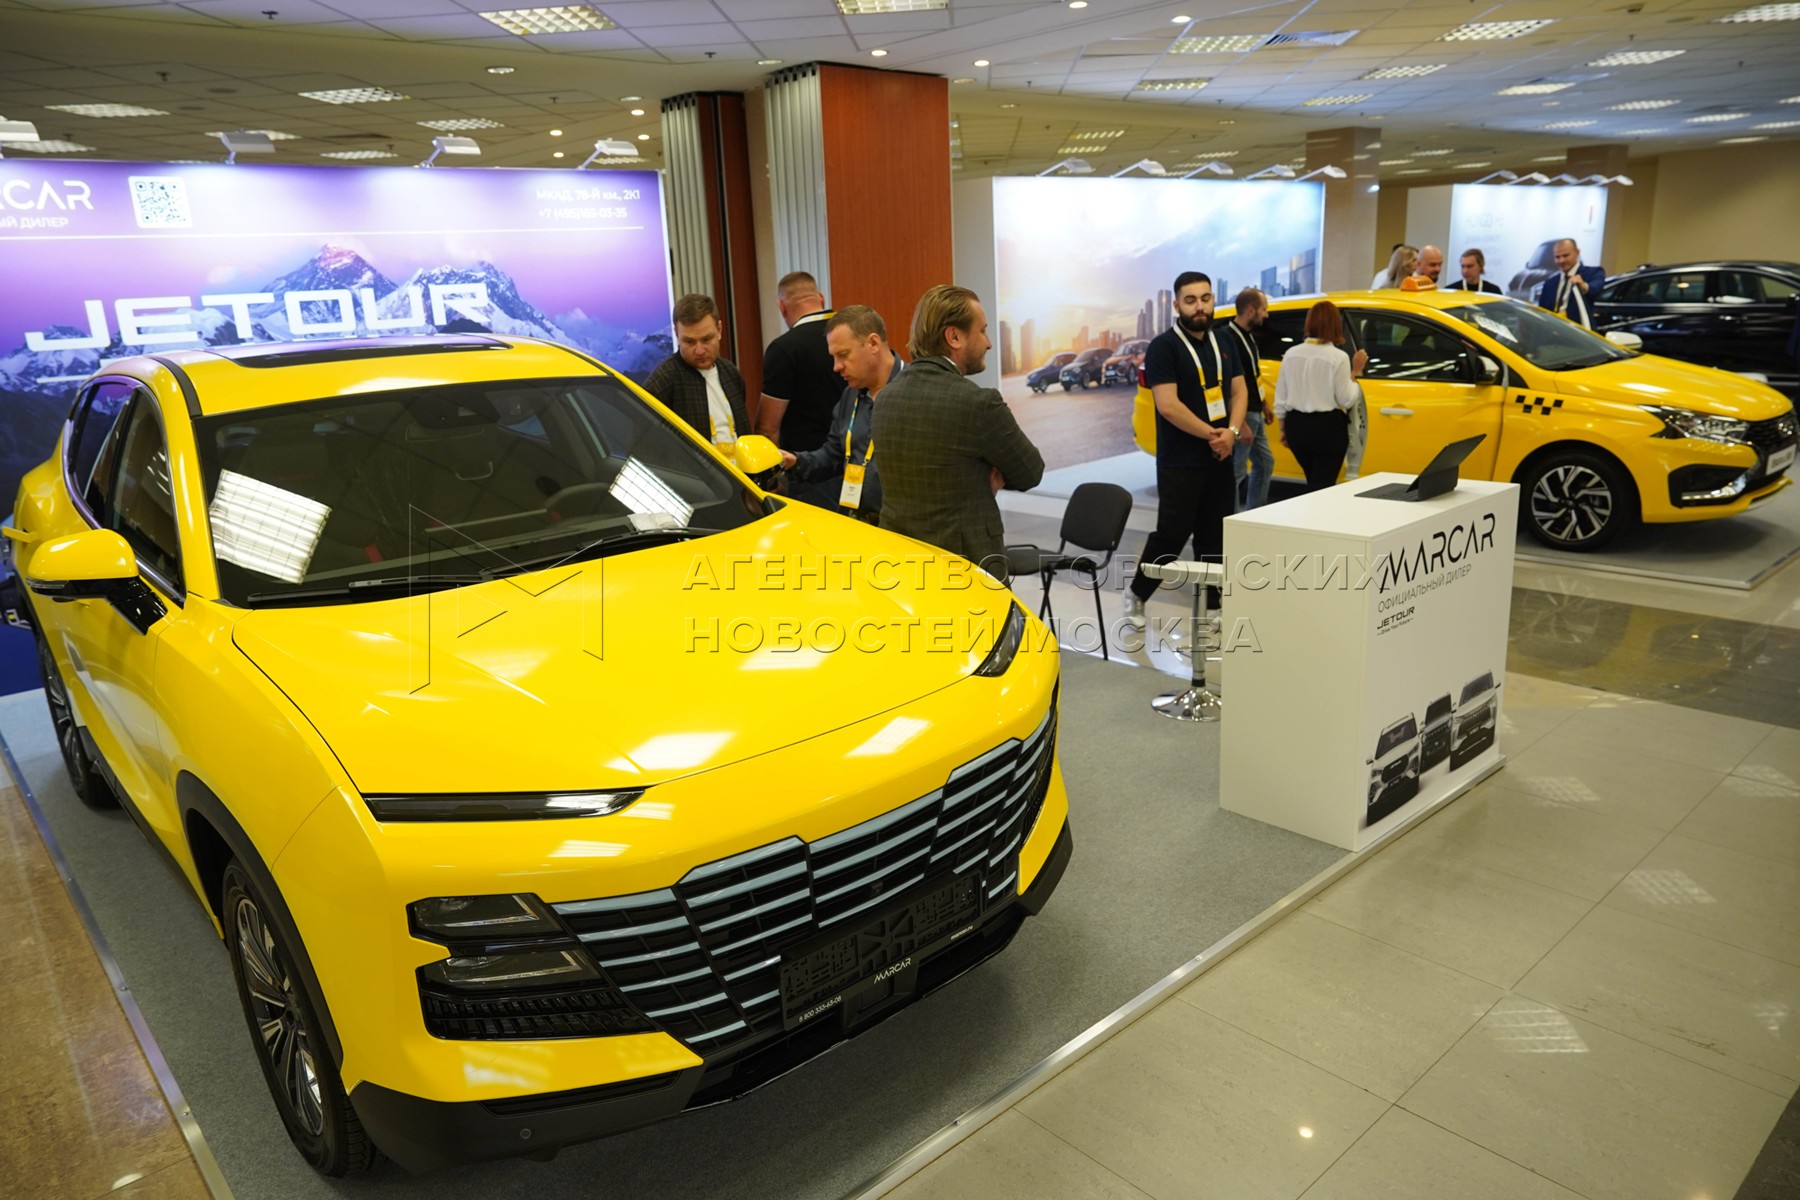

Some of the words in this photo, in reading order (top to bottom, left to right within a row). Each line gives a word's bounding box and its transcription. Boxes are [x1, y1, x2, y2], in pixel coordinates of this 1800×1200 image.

[0, 179, 95, 211] CAR
[20, 216, 69, 230] ДИЛЕР
[24, 282, 492, 352] JETOUR
[1379, 512, 1496, 594] MARCAR
[1377, 572, 1445, 613] ОФИЦИАЛЬНЫЙ
[1445, 563, 1472, 586] ДИЛЕР
[1376, 605, 1415, 630] JETOUR
[873, 957, 912, 984] MARCAR
